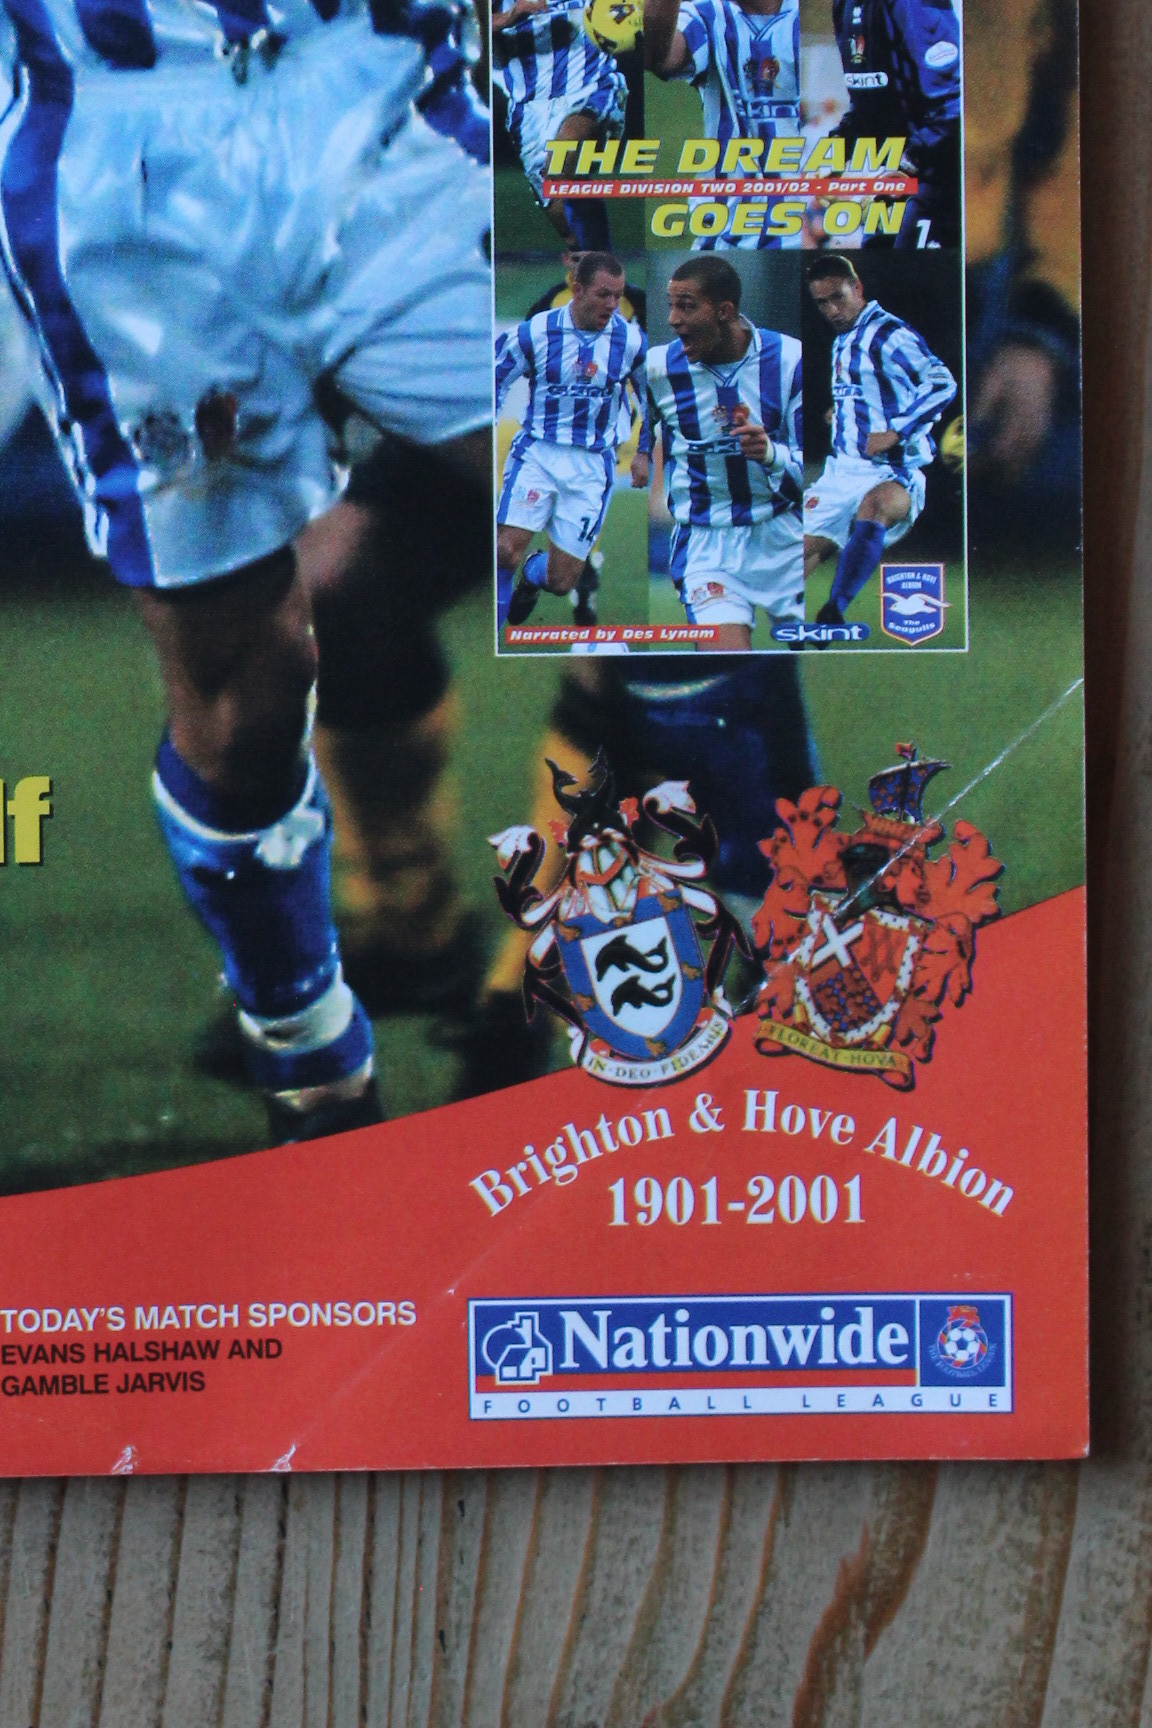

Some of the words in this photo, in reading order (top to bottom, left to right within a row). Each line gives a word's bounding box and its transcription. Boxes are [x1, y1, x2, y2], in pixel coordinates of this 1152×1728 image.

[544, 139, 661, 176] THE
[677, 137, 907, 174] DREAM
[549, 182, 614, 195] LEAGUE
[619, 182, 694, 194] DIVISION
[701, 182, 736, 193] TWO
[742, 181, 810, 194] 2001/02
[827, 181, 866, 193] Part
[873, 181, 907, 192] One
[650, 202, 806, 238] GOES
[822, 202, 906, 237] ON
[510, 628, 589, 641] Narrated
[595, 628, 615, 642] by
[622, 628, 653, 640] Des
[660, 627, 715, 641] Lynam
[776, 624, 863, 642] skint
[616, 1066, 650, 1079] DEO
[469, 1099, 675, 1217] Brighton
[689, 1093, 725, 1134] &
[742, 1089, 856, 1145] Hove
[865, 1118, 1016, 1217] Albion
[608, 1174, 866, 1227] 1901-2001
[0, 1307, 126, 1334] TODAY'S
[134, 1304, 239, 1330] MATCH
[248, 1301, 417, 1328] SPONSORS
[1, 1343, 85, 1365] EVANS
[94, 1340, 220, 1363] HALSHAW
[228, 1338, 282, 1359] AND
[559, 1307, 911, 1369] Nationwide
[1, 1374, 109, 1396] GAMBLE
[116, 1371, 206, 1393] JARVIS
[483, 1394, 753, 1415] FOOTBALL
[801, 1392, 999, 1411] LEAGUE
